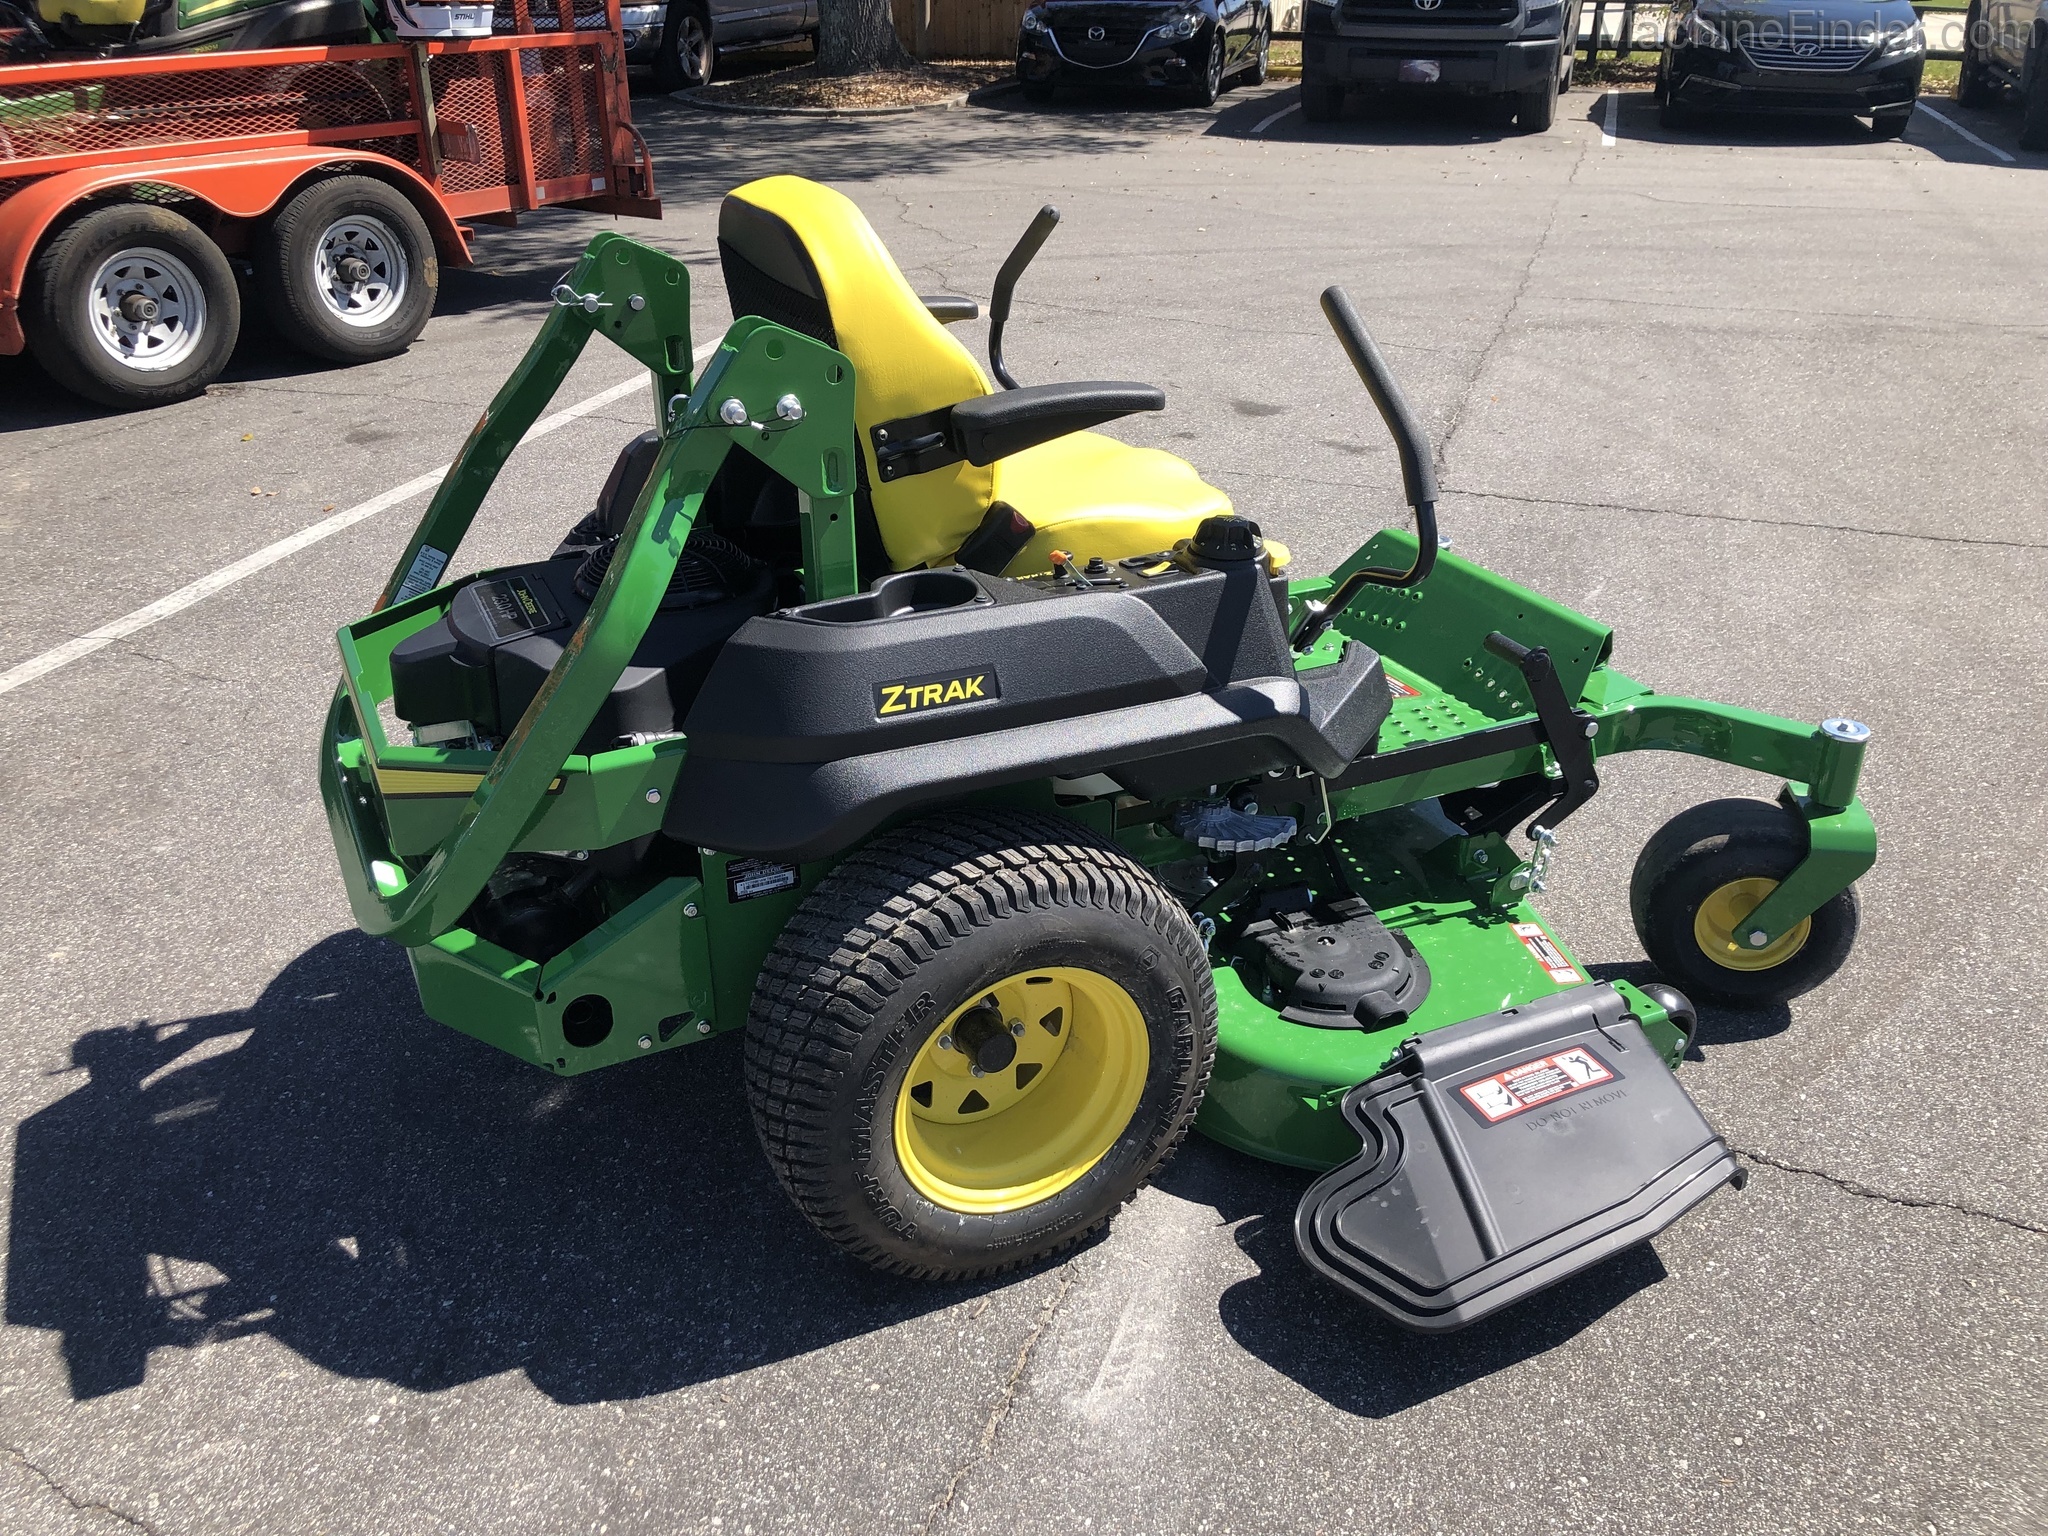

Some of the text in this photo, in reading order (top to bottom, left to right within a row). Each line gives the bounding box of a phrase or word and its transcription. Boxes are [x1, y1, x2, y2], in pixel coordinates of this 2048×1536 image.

[880, 675, 985, 714] ZTRAK
[1525, 1117, 1548, 1132] DO
[1550, 1106, 1578, 1122] NOT
